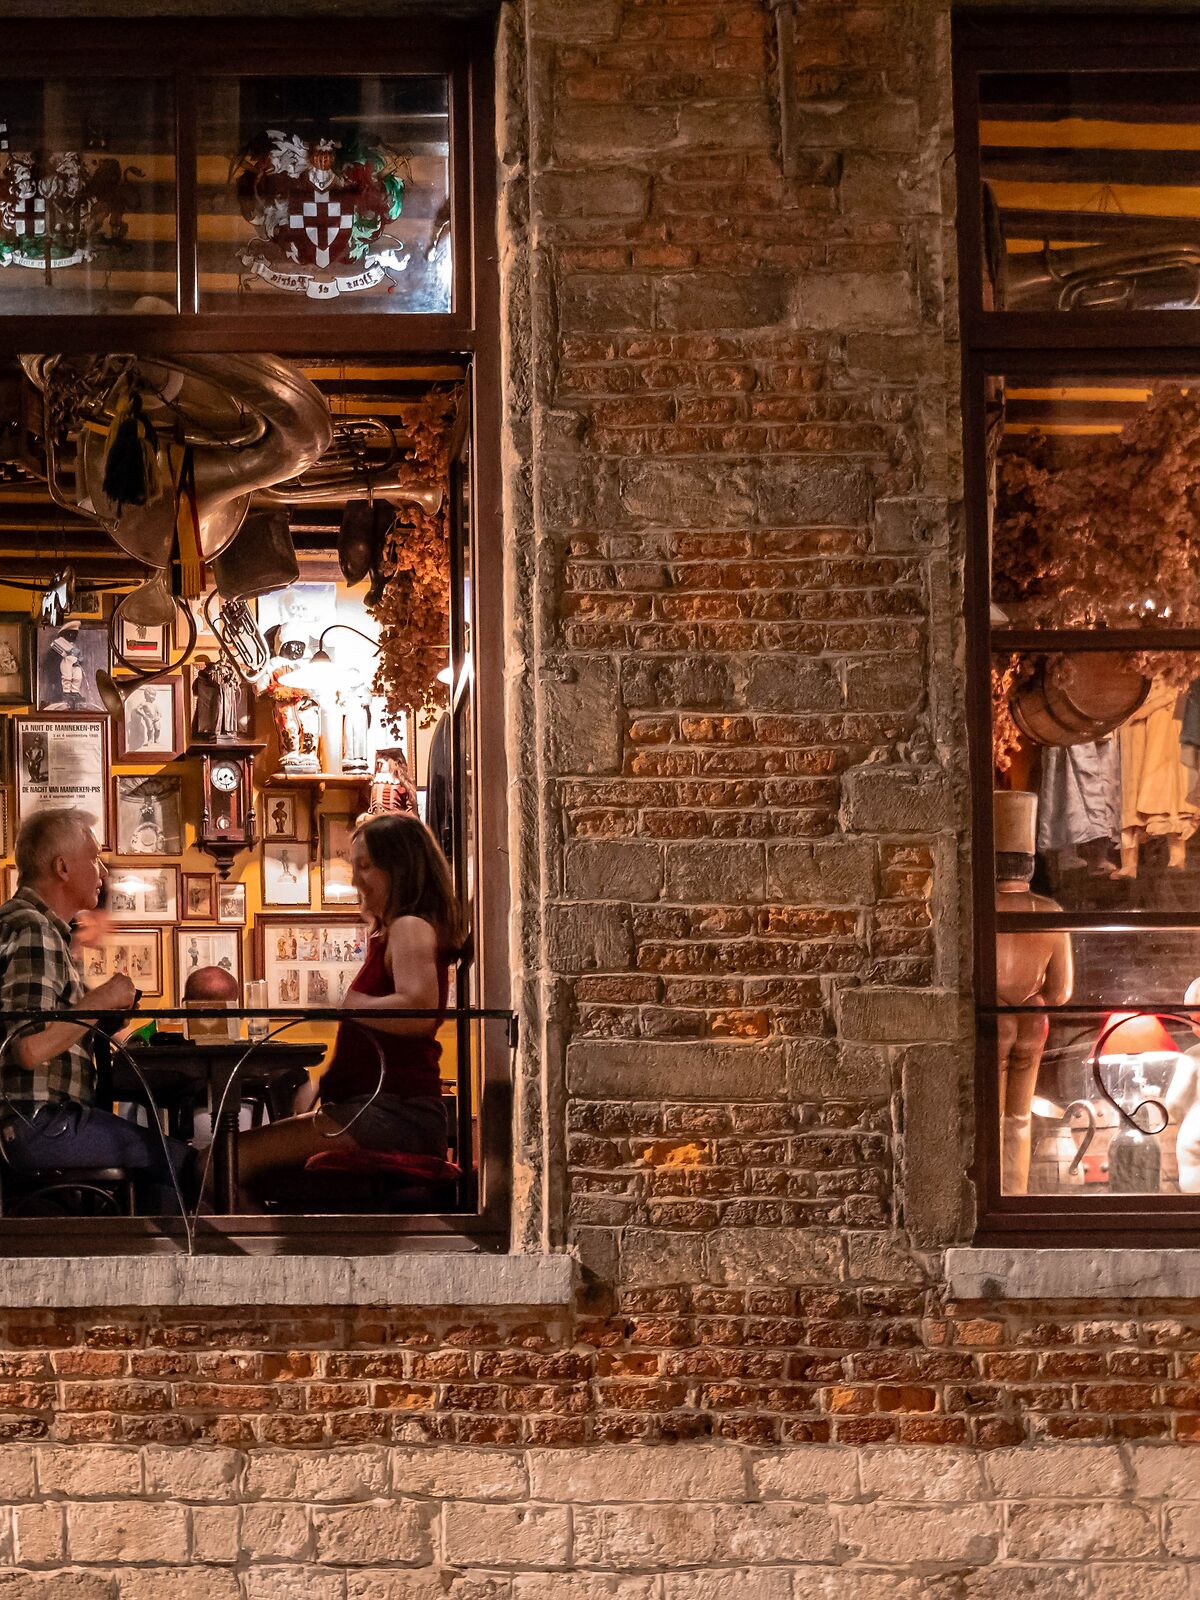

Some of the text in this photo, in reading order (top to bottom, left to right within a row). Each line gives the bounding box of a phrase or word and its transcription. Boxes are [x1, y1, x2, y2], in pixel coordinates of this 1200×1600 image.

[21, 724, 100, 732] LA NUIT DE MANNEKEN-PIS
